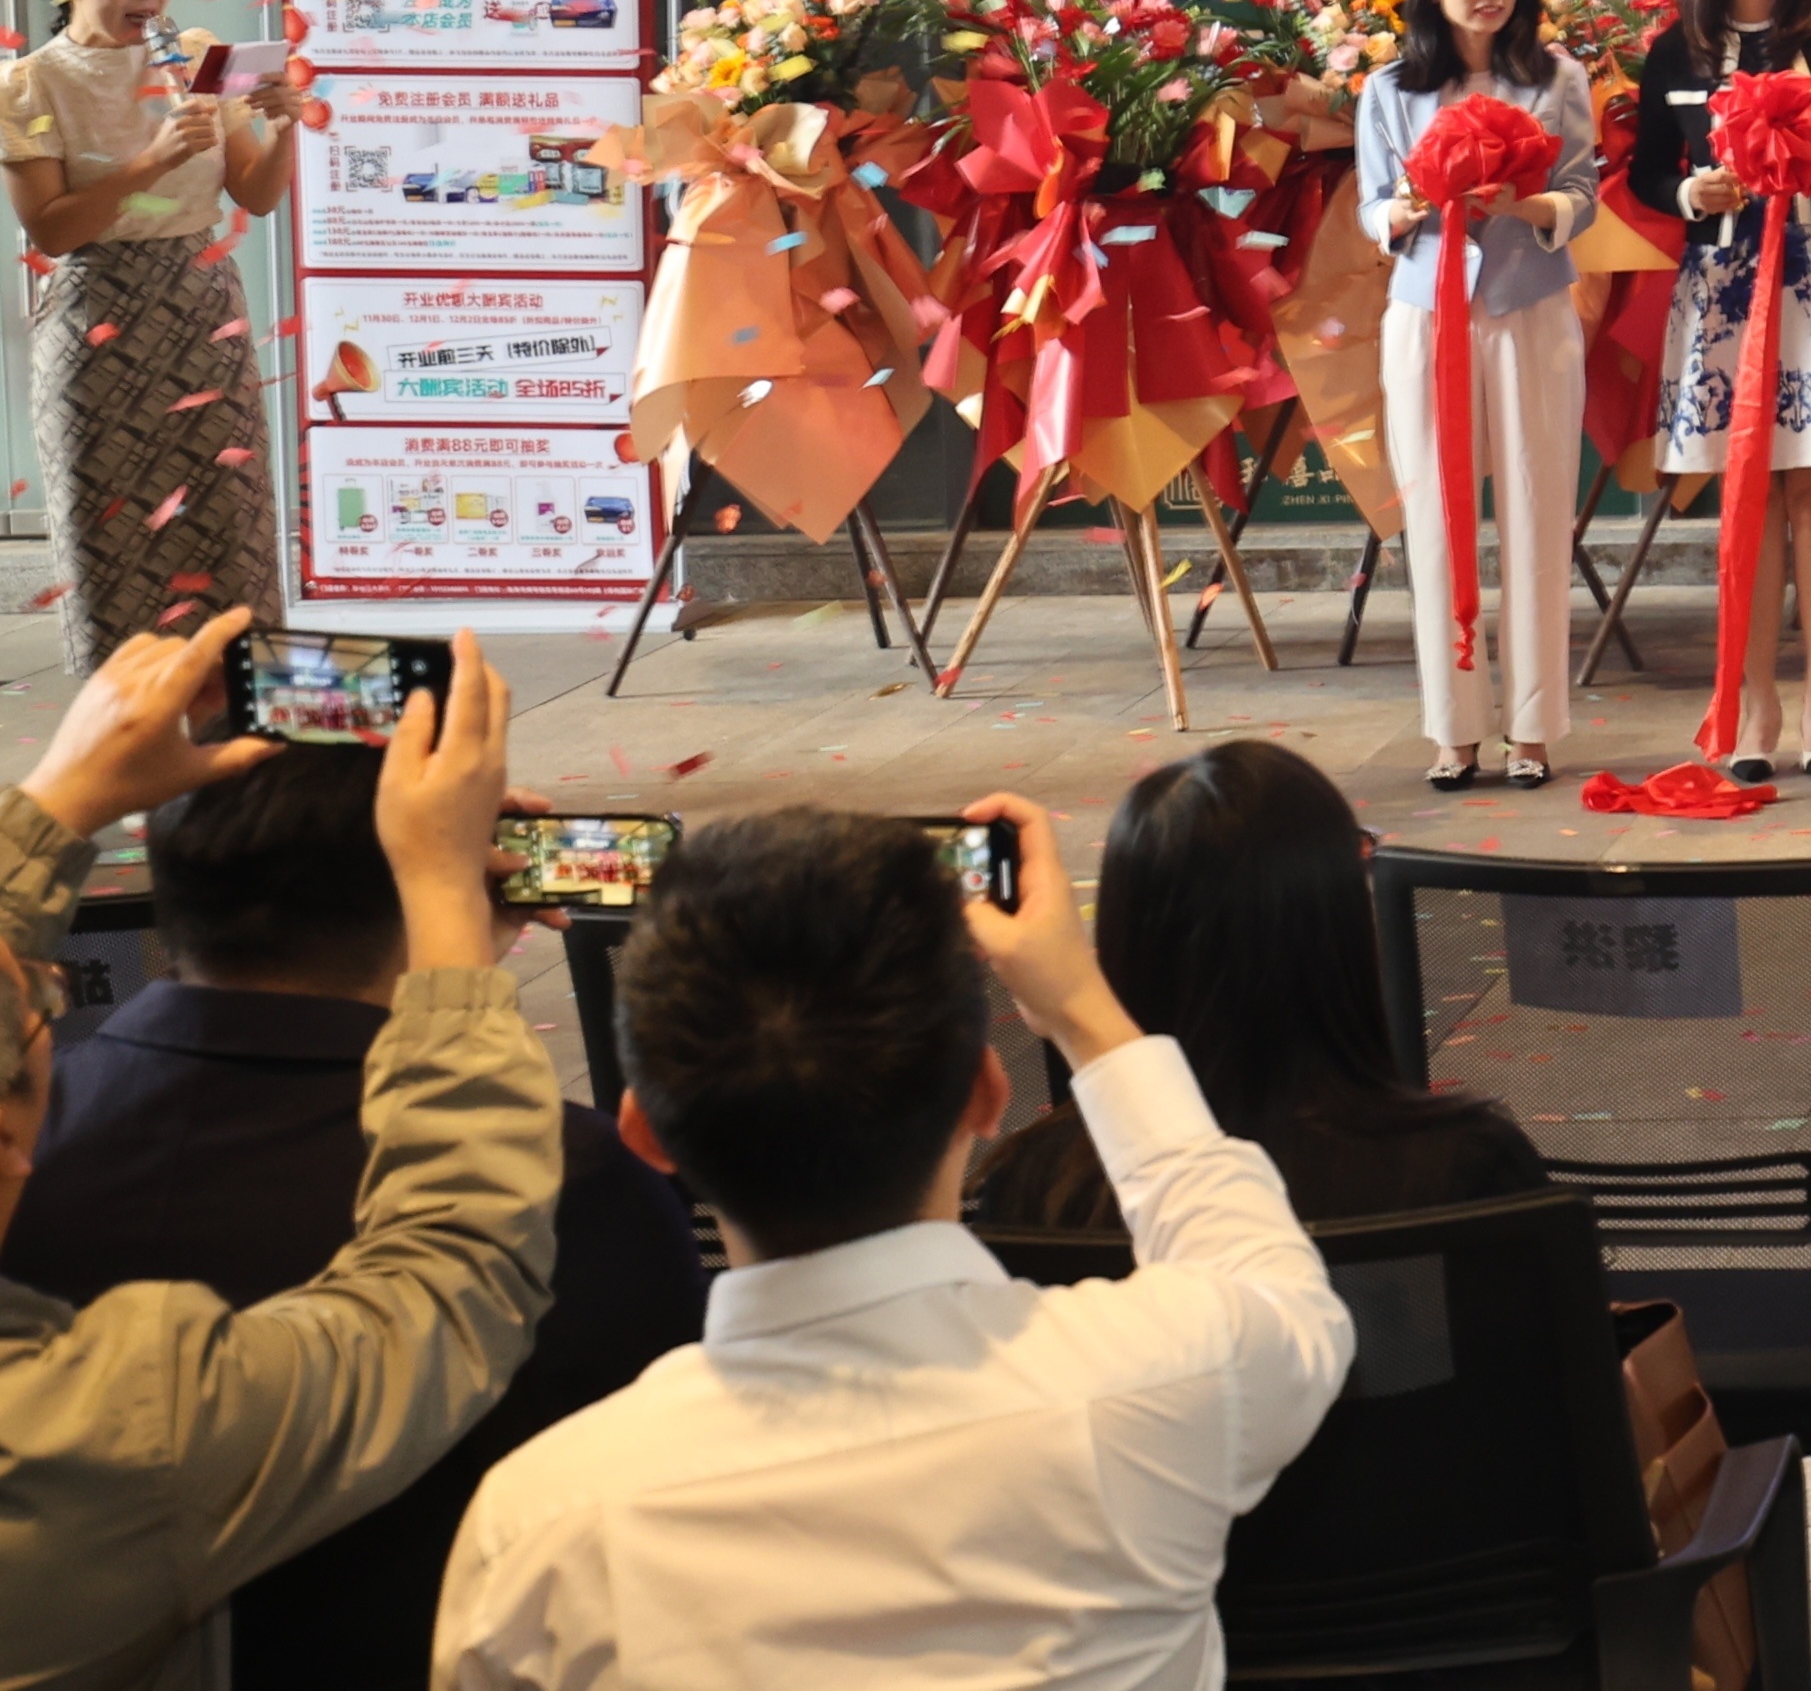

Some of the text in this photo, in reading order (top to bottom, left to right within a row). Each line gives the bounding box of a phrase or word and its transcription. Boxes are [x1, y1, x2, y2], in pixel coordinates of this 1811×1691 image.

[377, 91, 560, 108] 免费注册会员 满额送礼品
